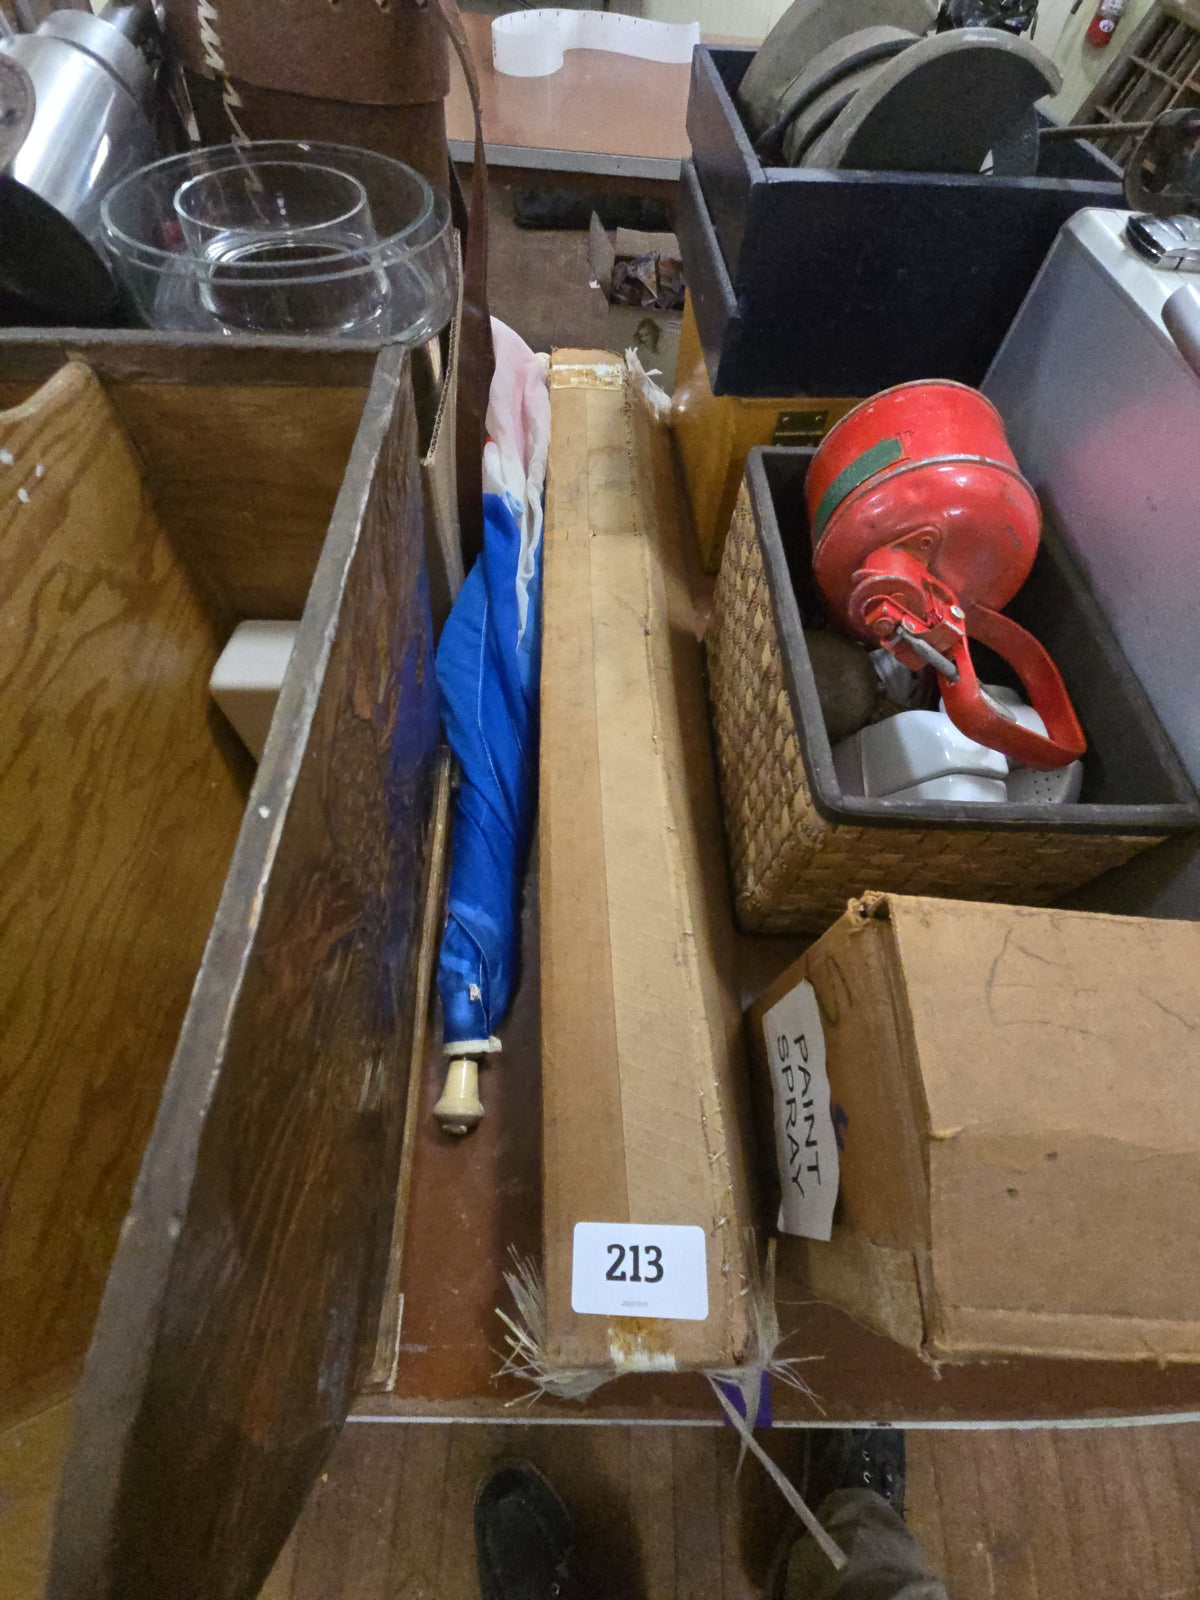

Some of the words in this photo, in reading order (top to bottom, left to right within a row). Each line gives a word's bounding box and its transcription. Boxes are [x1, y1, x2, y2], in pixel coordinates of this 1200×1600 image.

[777, 1034, 805, 1197] SPRAY
[794, 1034, 822, 1186] PAINT
[605, 1243, 664, 1283] 213
